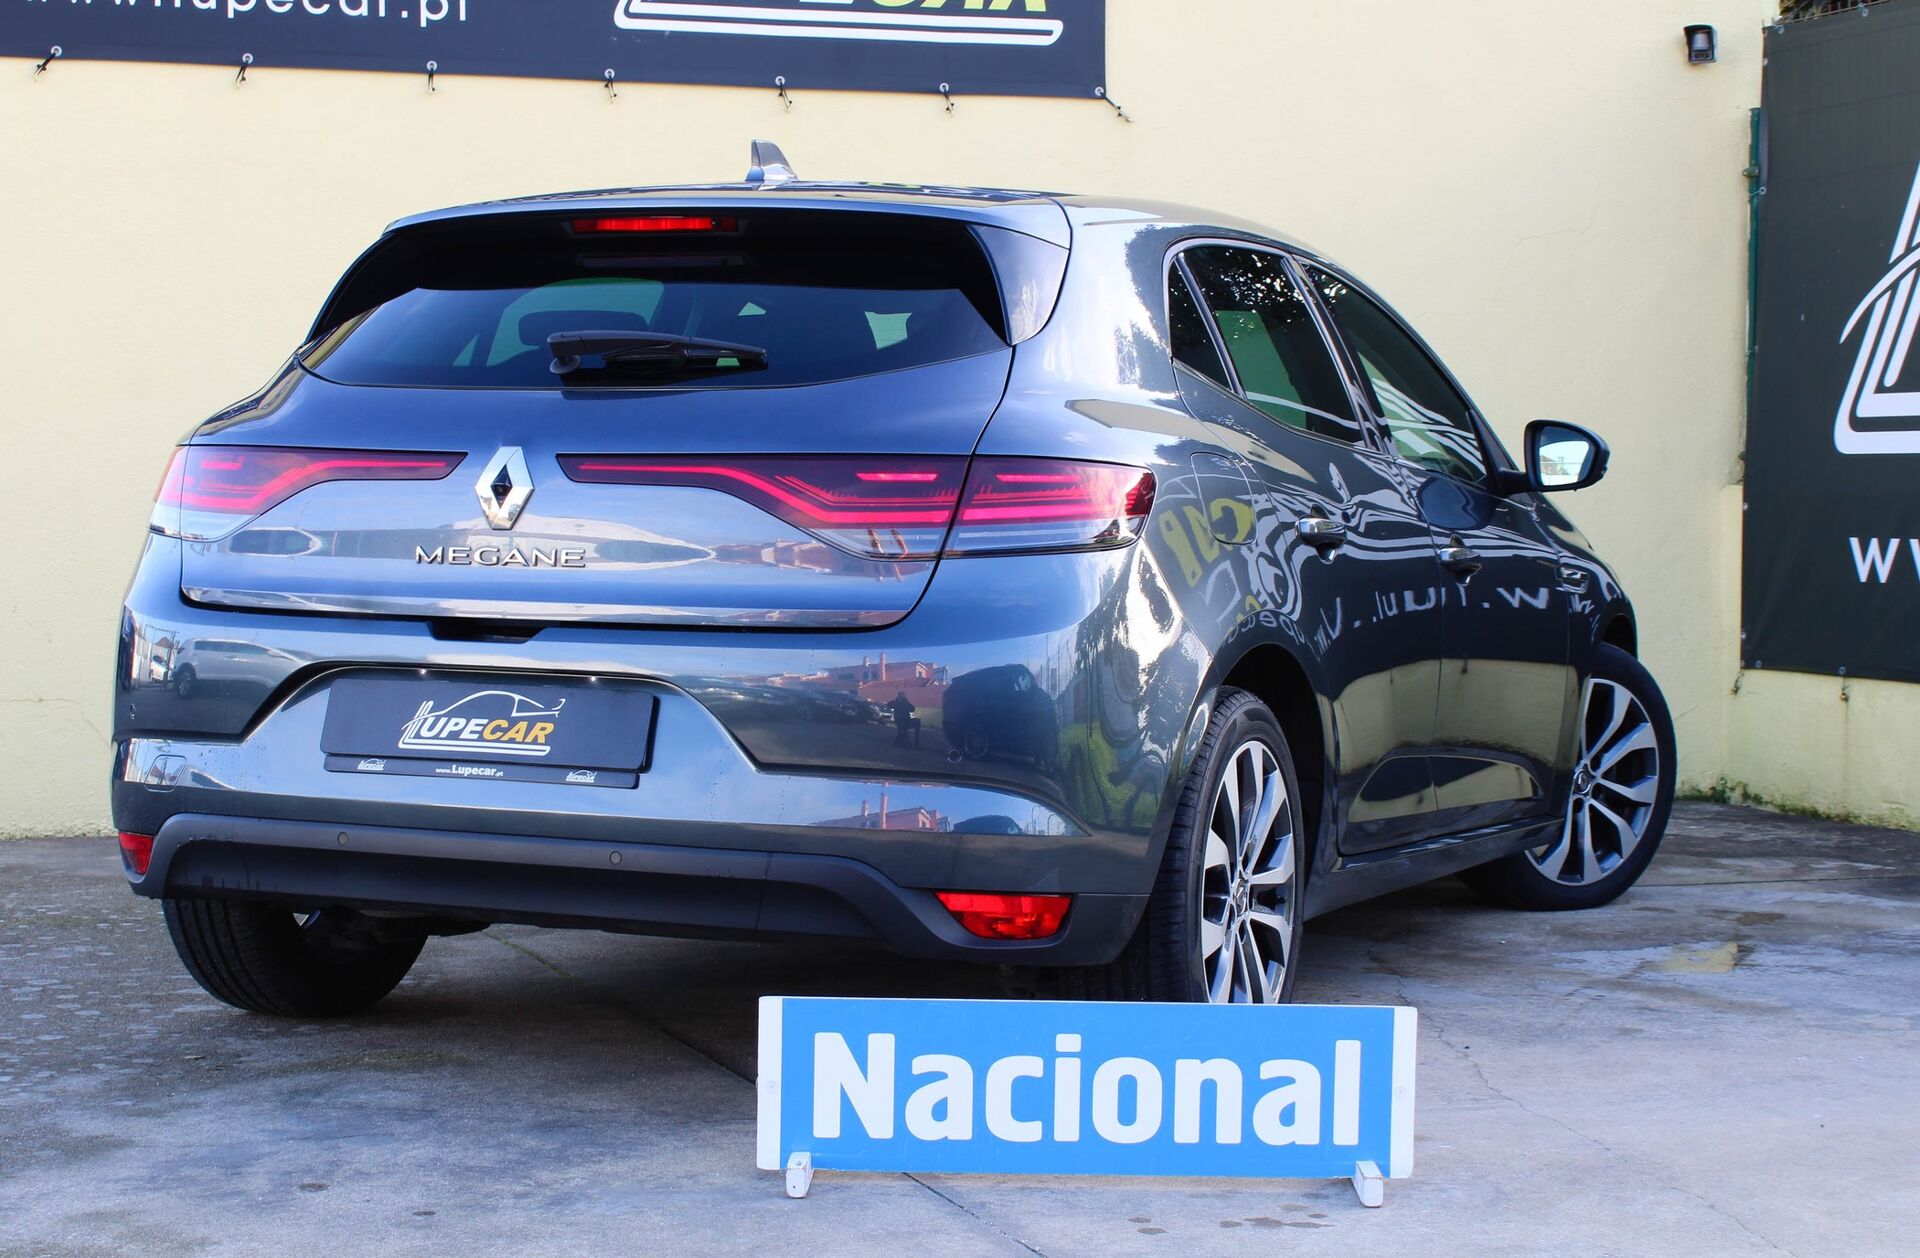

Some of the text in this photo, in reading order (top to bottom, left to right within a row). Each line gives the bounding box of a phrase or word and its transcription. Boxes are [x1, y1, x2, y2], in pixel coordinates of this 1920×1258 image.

[416, 545, 586, 567] MEGANE
[397, 701, 555, 757] LUPECAR
[435, 764, 504, 777] www.Lupecar.pt
[812, 1032, 1362, 1146] Nacional
